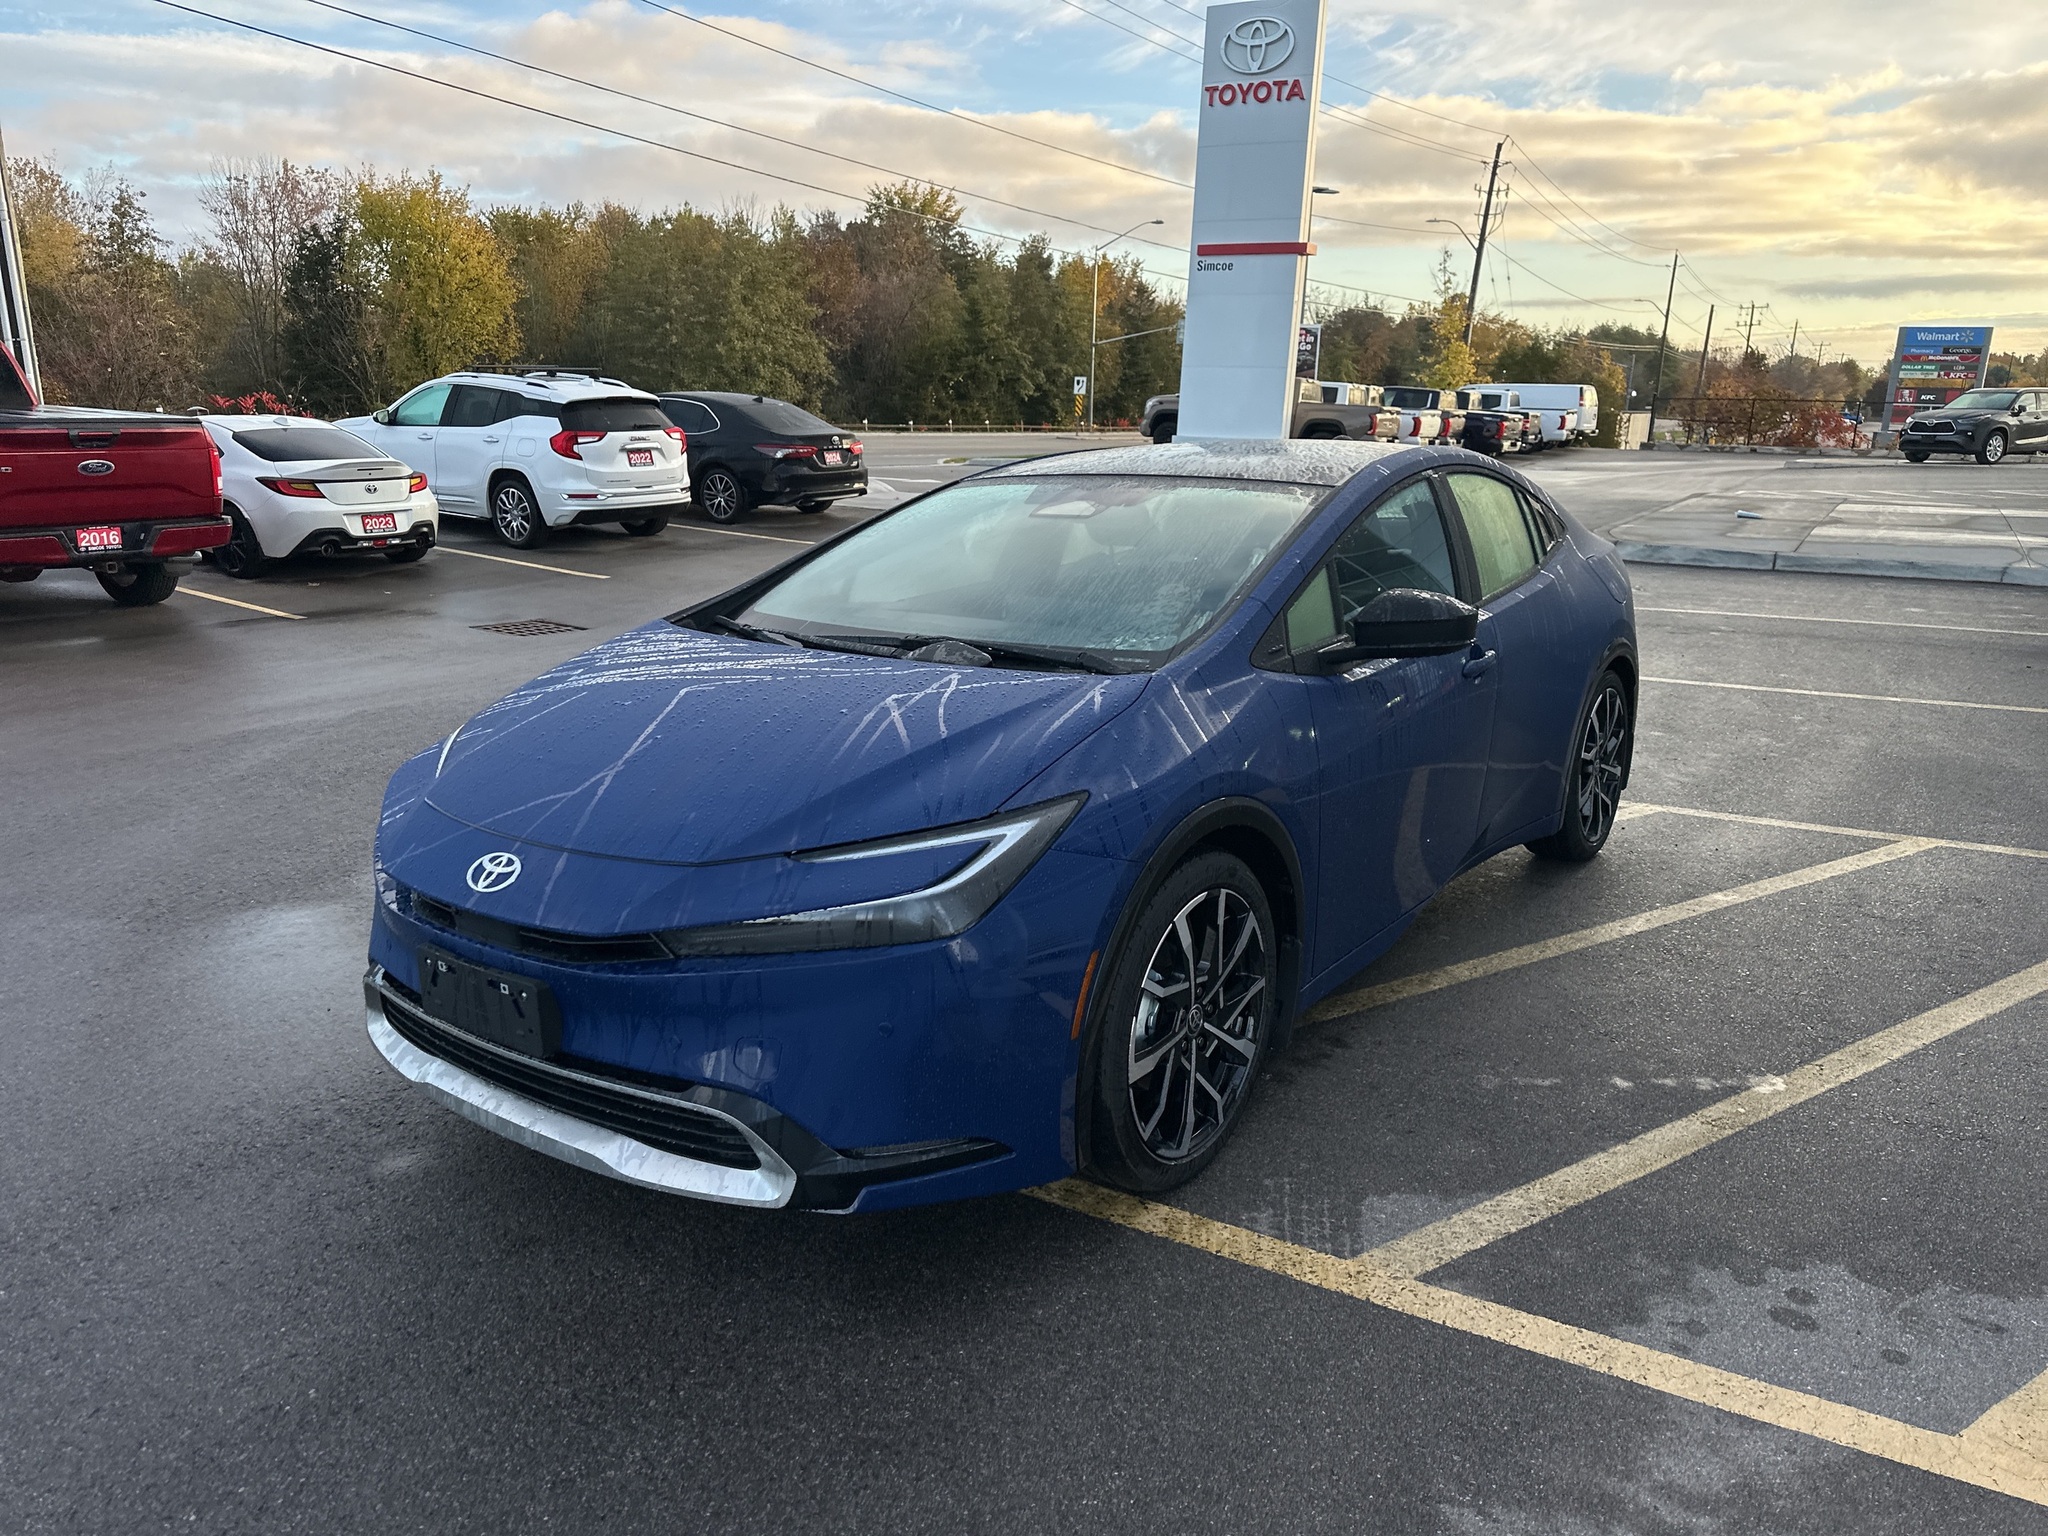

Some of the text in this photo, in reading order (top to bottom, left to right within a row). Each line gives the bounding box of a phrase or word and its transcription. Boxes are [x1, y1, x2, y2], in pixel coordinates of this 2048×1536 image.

[1204, 79, 1305, 107] TOYOTA
[1197, 260, 1234, 272] Simcoe
[1917, 332, 1960, 341] Walmart
[1299, 342, 1312, 350] Go
[629, 453, 652, 463] 2022
[365, 517, 394, 529] 2023
[80, 531, 119, 546] 2016
